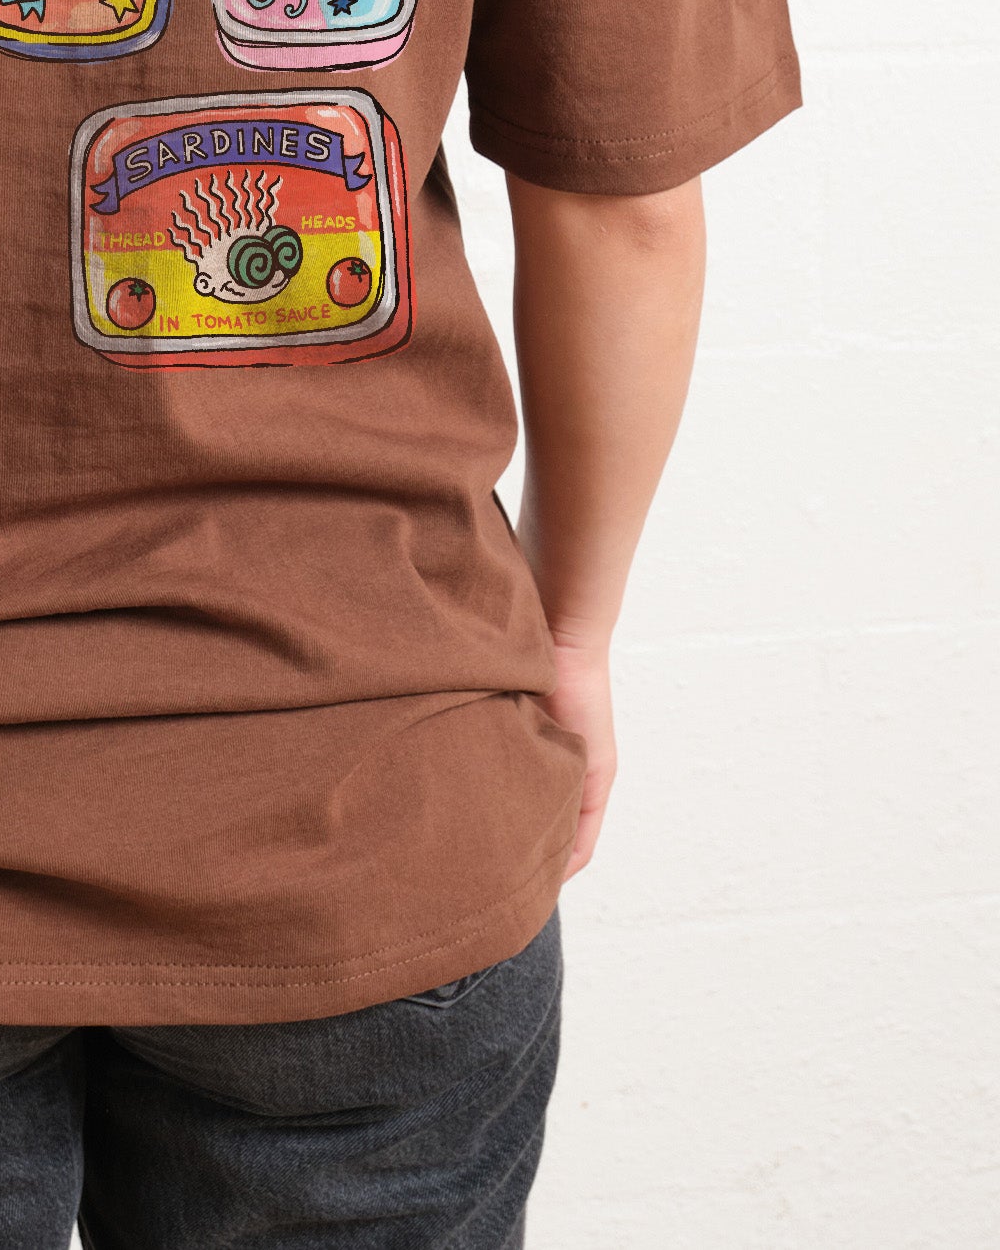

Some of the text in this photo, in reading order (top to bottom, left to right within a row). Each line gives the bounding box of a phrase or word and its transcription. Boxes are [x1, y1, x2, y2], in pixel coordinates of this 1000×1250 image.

[124, 126, 333, 183] SARDINES
[98, 215, 356, 249] THREAD HEADS
[158, 304, 332, 333] IN TOMATO SAUCE
